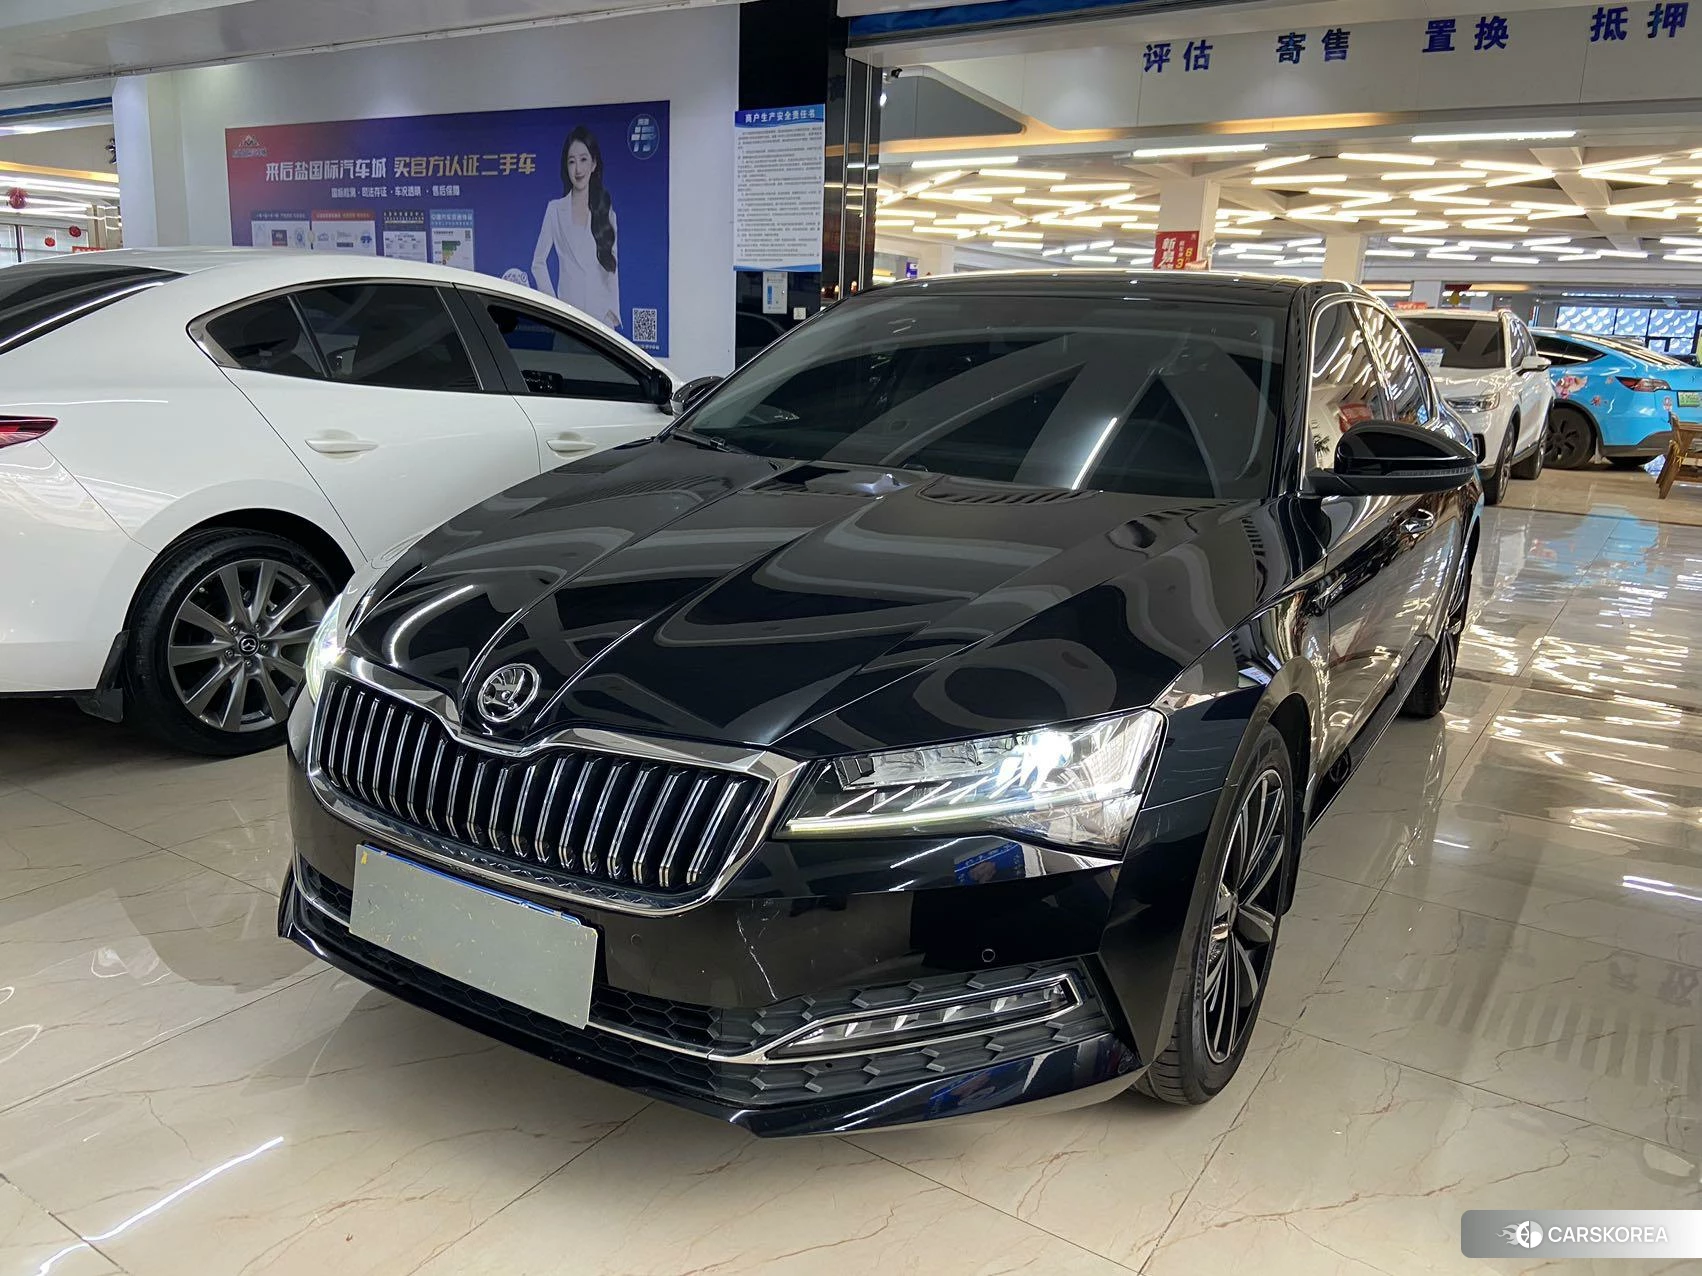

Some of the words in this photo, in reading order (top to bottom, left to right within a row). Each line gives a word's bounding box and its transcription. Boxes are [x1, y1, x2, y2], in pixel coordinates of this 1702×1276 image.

[1143, 40, 1213, 73] 评估
[1276, 28, 1350, 64] 寄售
[1422, 15, 1509, 53] 置换
[1590, 2, 1689, 42] 抵押
[745, 109, 816, 123] 商户生产安全责任书
[266, 158, 387, 181] 来后盐国际汽车城
[394, 153, 537, 177] 买官方认证二手车
